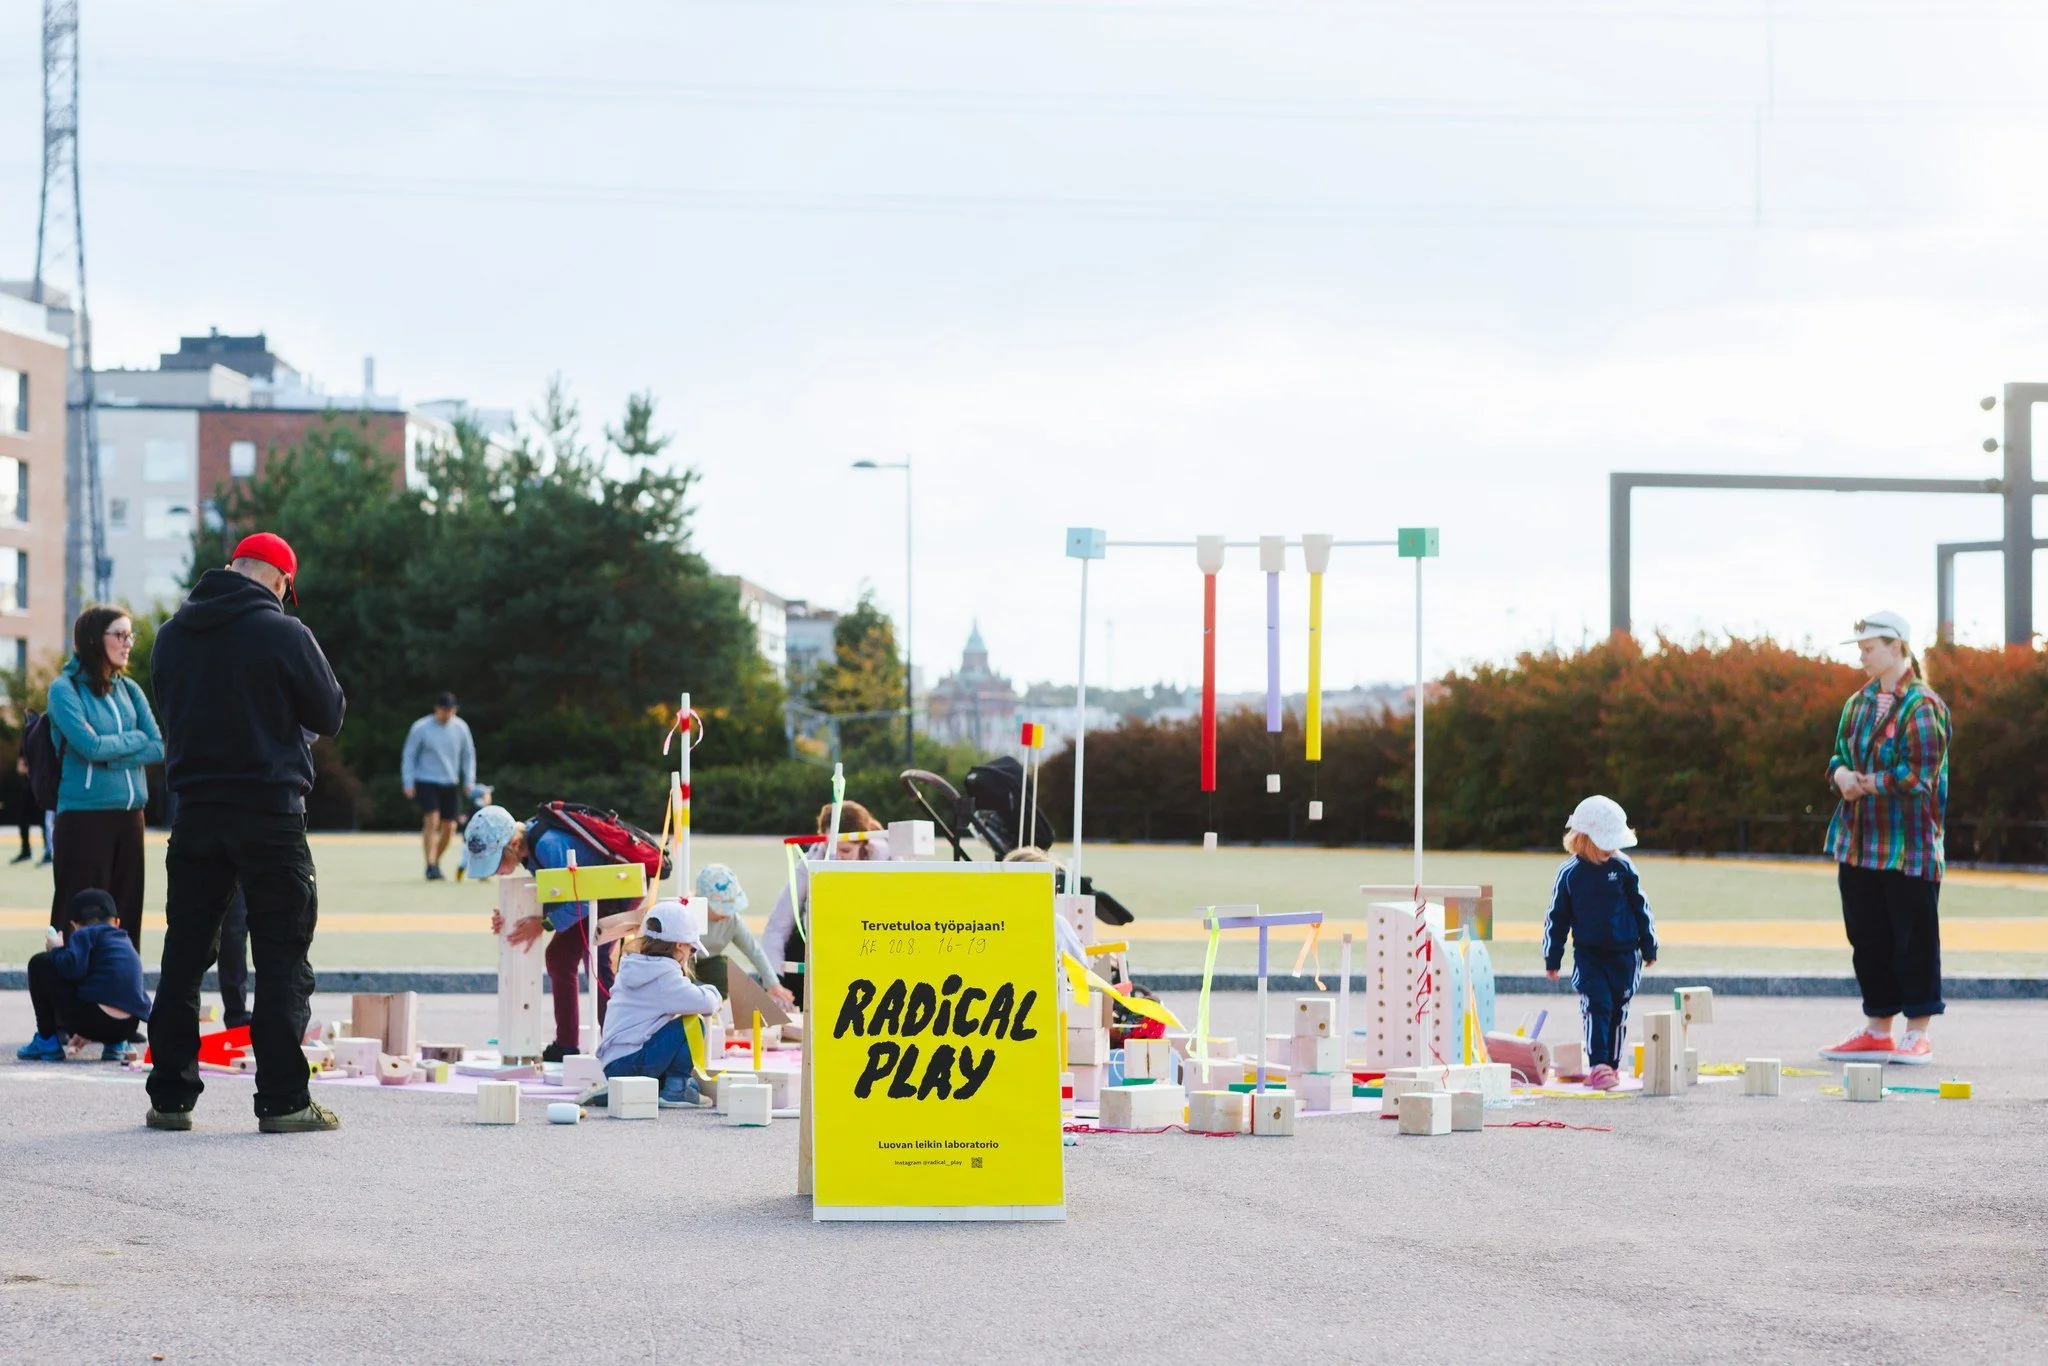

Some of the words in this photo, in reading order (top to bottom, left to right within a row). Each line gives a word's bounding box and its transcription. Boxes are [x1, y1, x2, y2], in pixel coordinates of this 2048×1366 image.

[861, 920, 931, 931] Tervetuloa
[934, 920, 1005, 934] työpajaan!
[860, 938, 877, 957] KE
[854, 1041, 996, 1101] PLAY
[878, 1140, 913, 1149] Luovan
[915, 1140, 943, 1149] leikin
[944, 1140, 999, 1149] laboratorio
